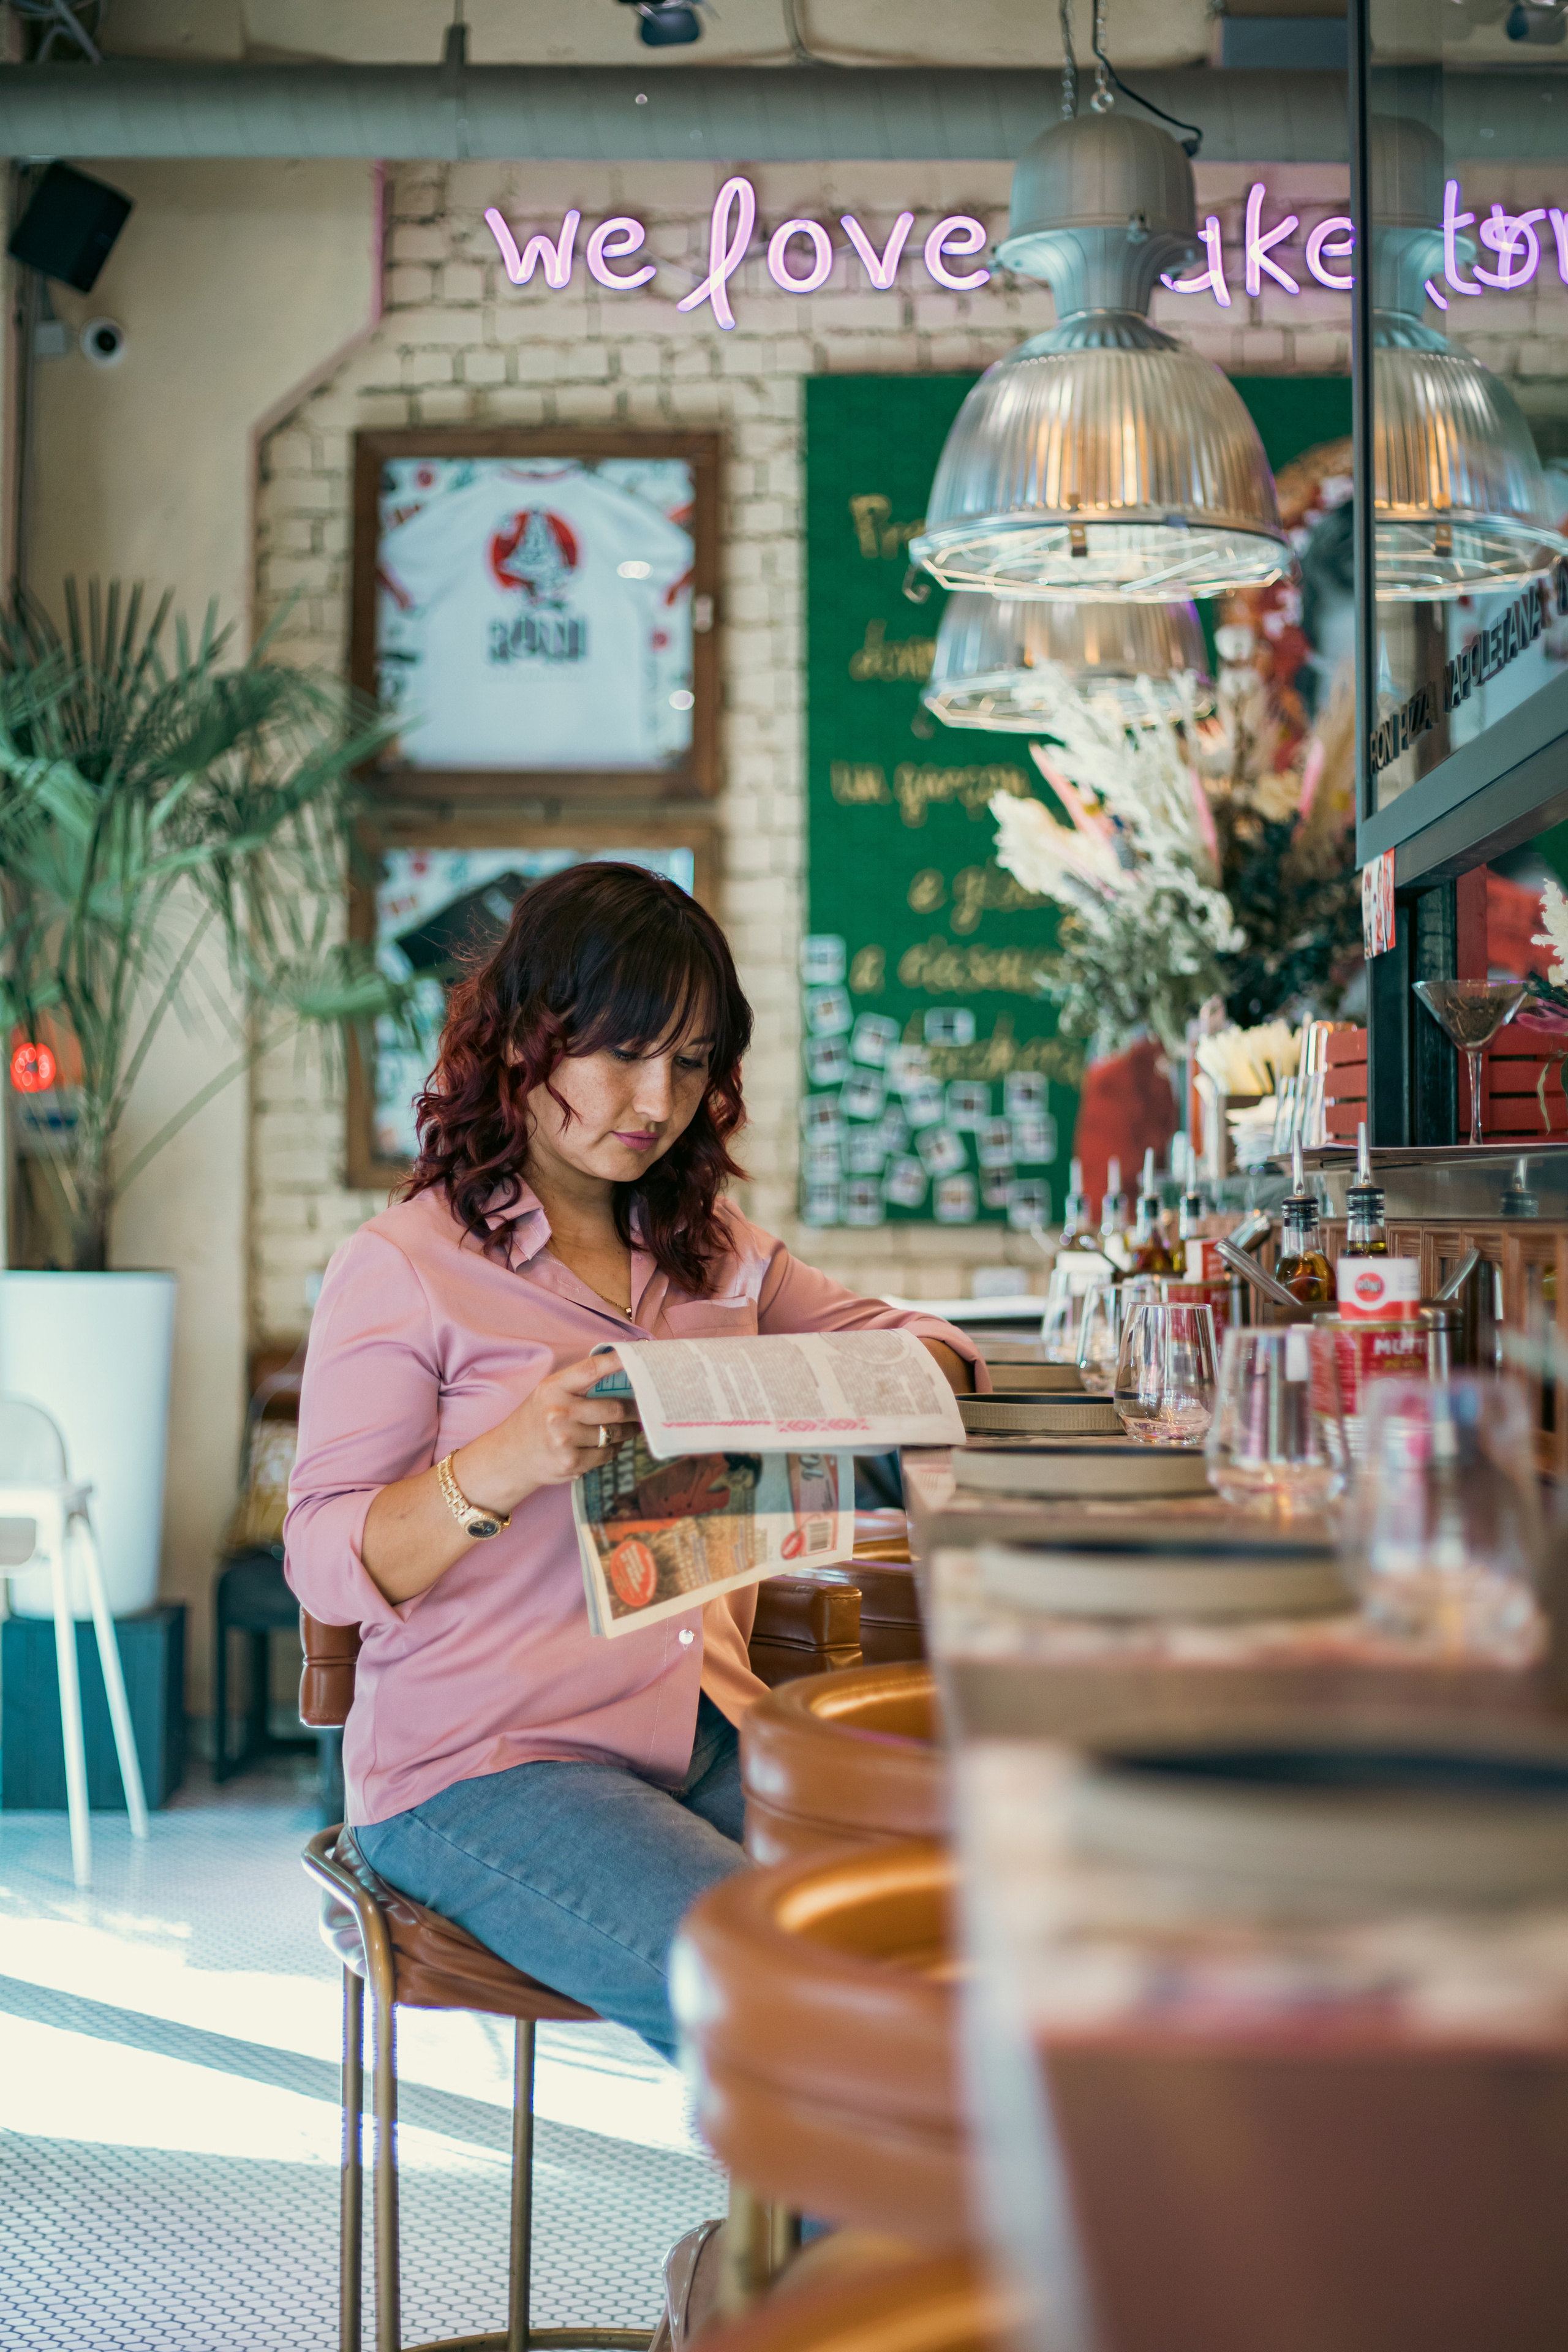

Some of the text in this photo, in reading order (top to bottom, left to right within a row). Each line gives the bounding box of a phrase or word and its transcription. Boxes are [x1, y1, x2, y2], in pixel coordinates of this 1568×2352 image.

[484, 207, 657, 290] we
[677, 177, 990, 330] love
[1400, 681, 1438, 751] PIZZA
[1443, 578, 1551, 713] NAPOLETANA
